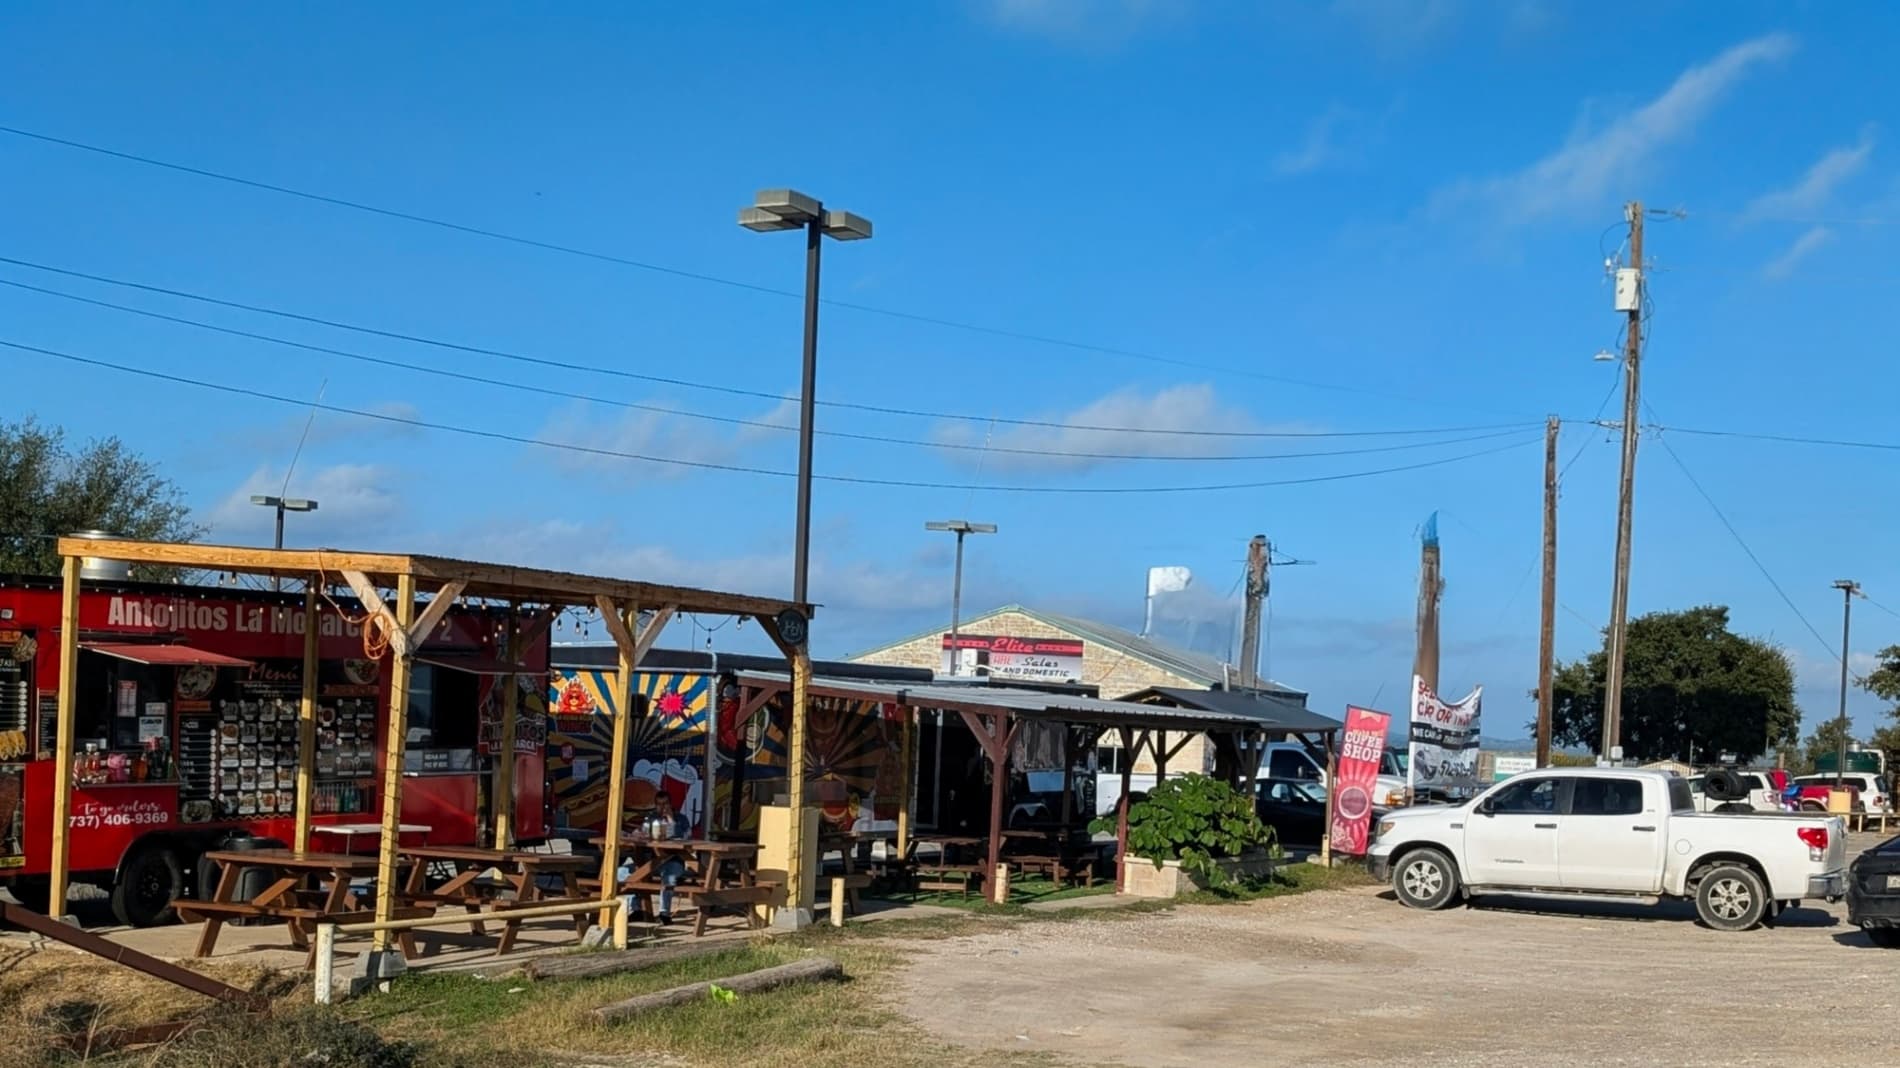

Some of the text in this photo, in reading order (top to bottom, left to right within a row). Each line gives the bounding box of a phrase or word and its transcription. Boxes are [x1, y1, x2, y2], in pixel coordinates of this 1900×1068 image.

[108, 596, 228, 632] Antojitos
[236, 604, 263, 632] La
[270, 605, 372, 638] Moarc
[990, 637, 1035, 653] Elite
[1021, 656, 1059, 668] Sales
[1002, 666, 1021, 675] AND
[1022, 667, 1070, 678] DOMESTIC
[1343, 743, 1381, 763] SHOP
[69, 811, 168, 829] 737) 406-9369
